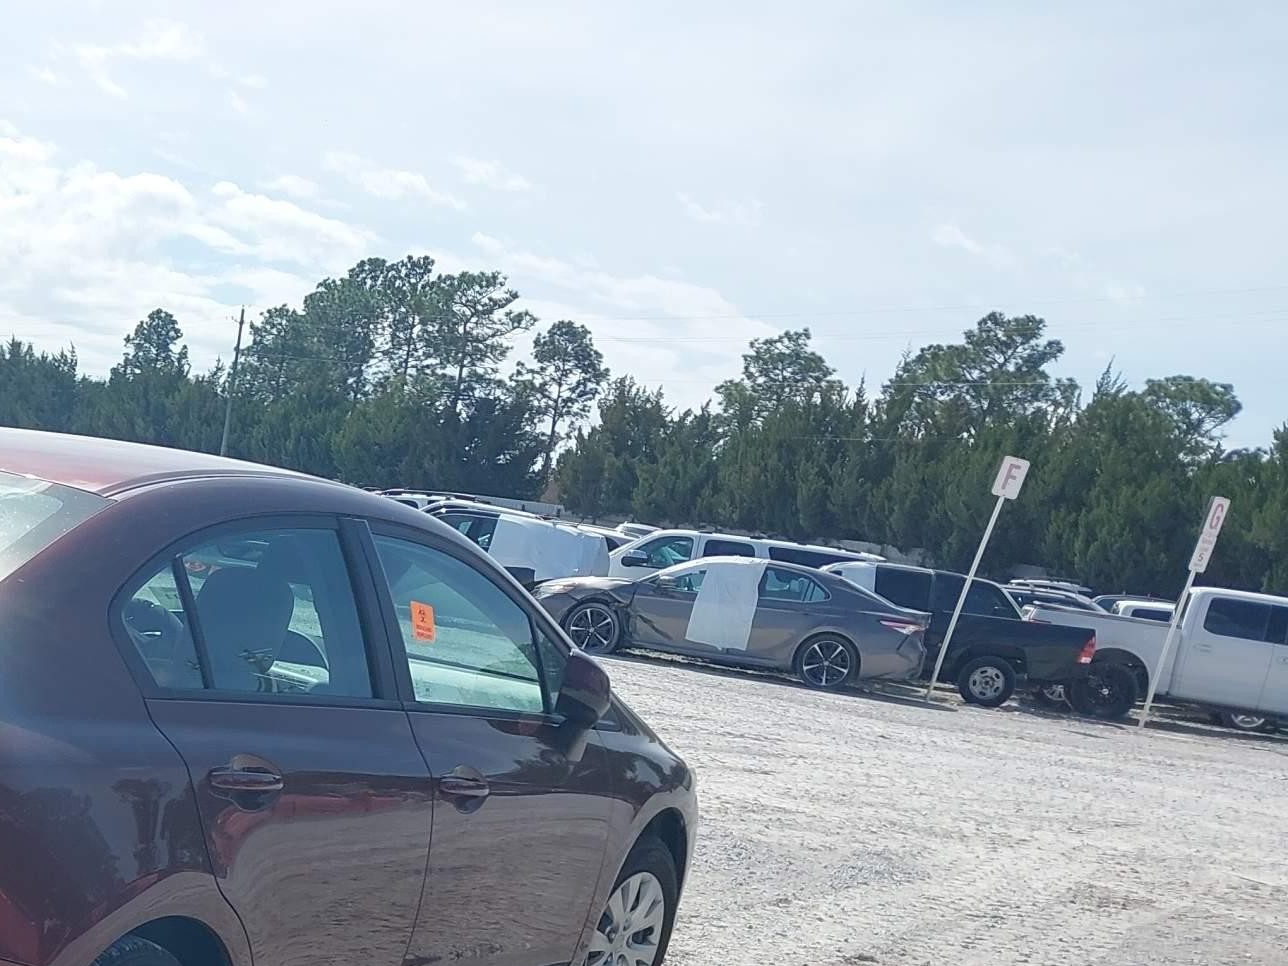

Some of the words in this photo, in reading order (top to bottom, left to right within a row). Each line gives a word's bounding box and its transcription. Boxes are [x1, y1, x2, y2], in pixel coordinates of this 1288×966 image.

[1001, 463, 1021, 490] F
[1209, 503, 1224, 530] G
[1197, 552, 1205, 562] 5
